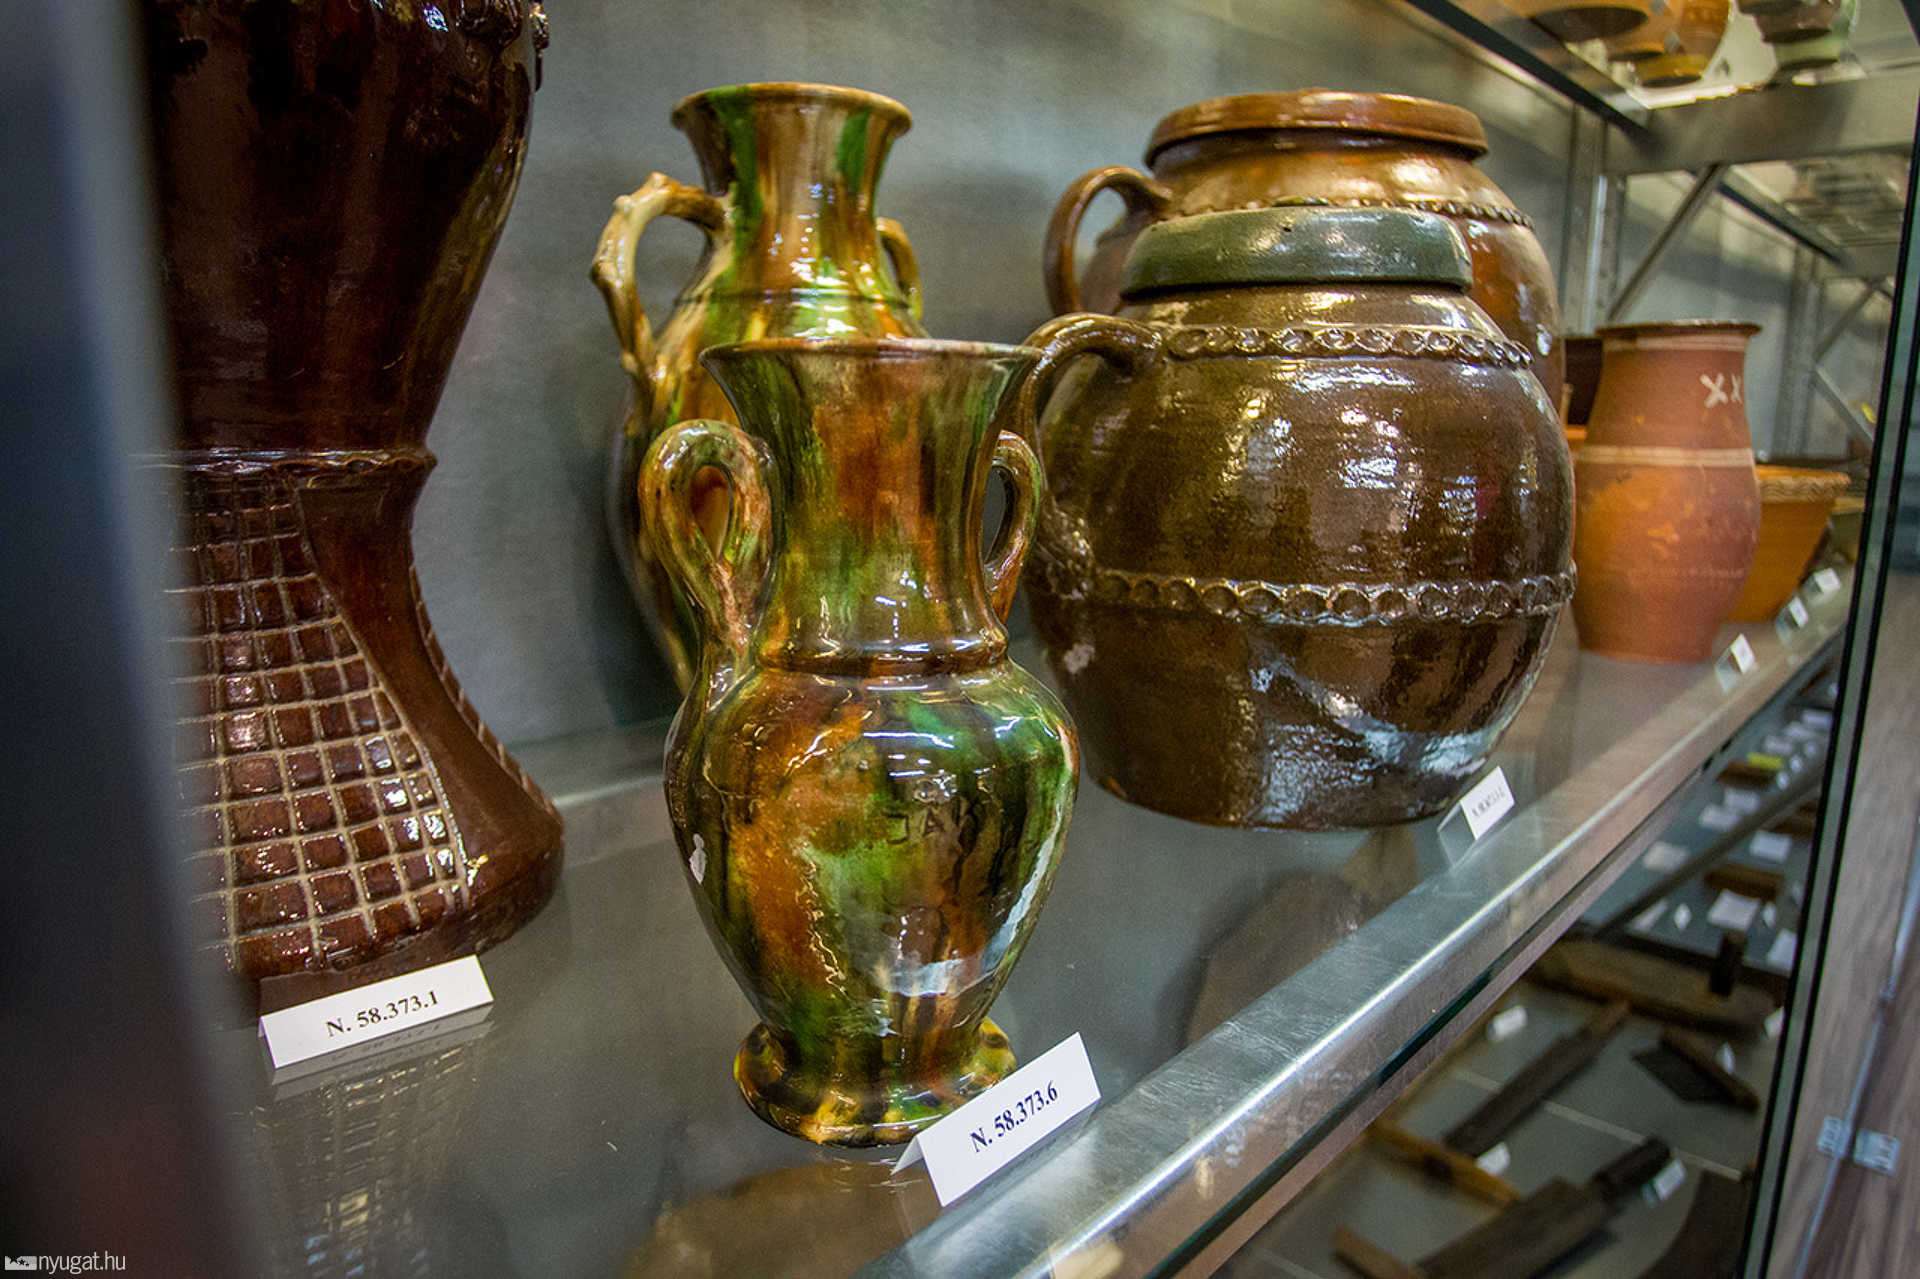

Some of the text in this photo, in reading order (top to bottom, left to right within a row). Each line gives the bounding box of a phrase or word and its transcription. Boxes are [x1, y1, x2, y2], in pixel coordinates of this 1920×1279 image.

[325, 990, 438, 1037] N. 58.373.1
[969, 1080, 1058, 1153] N. 58.373.6
